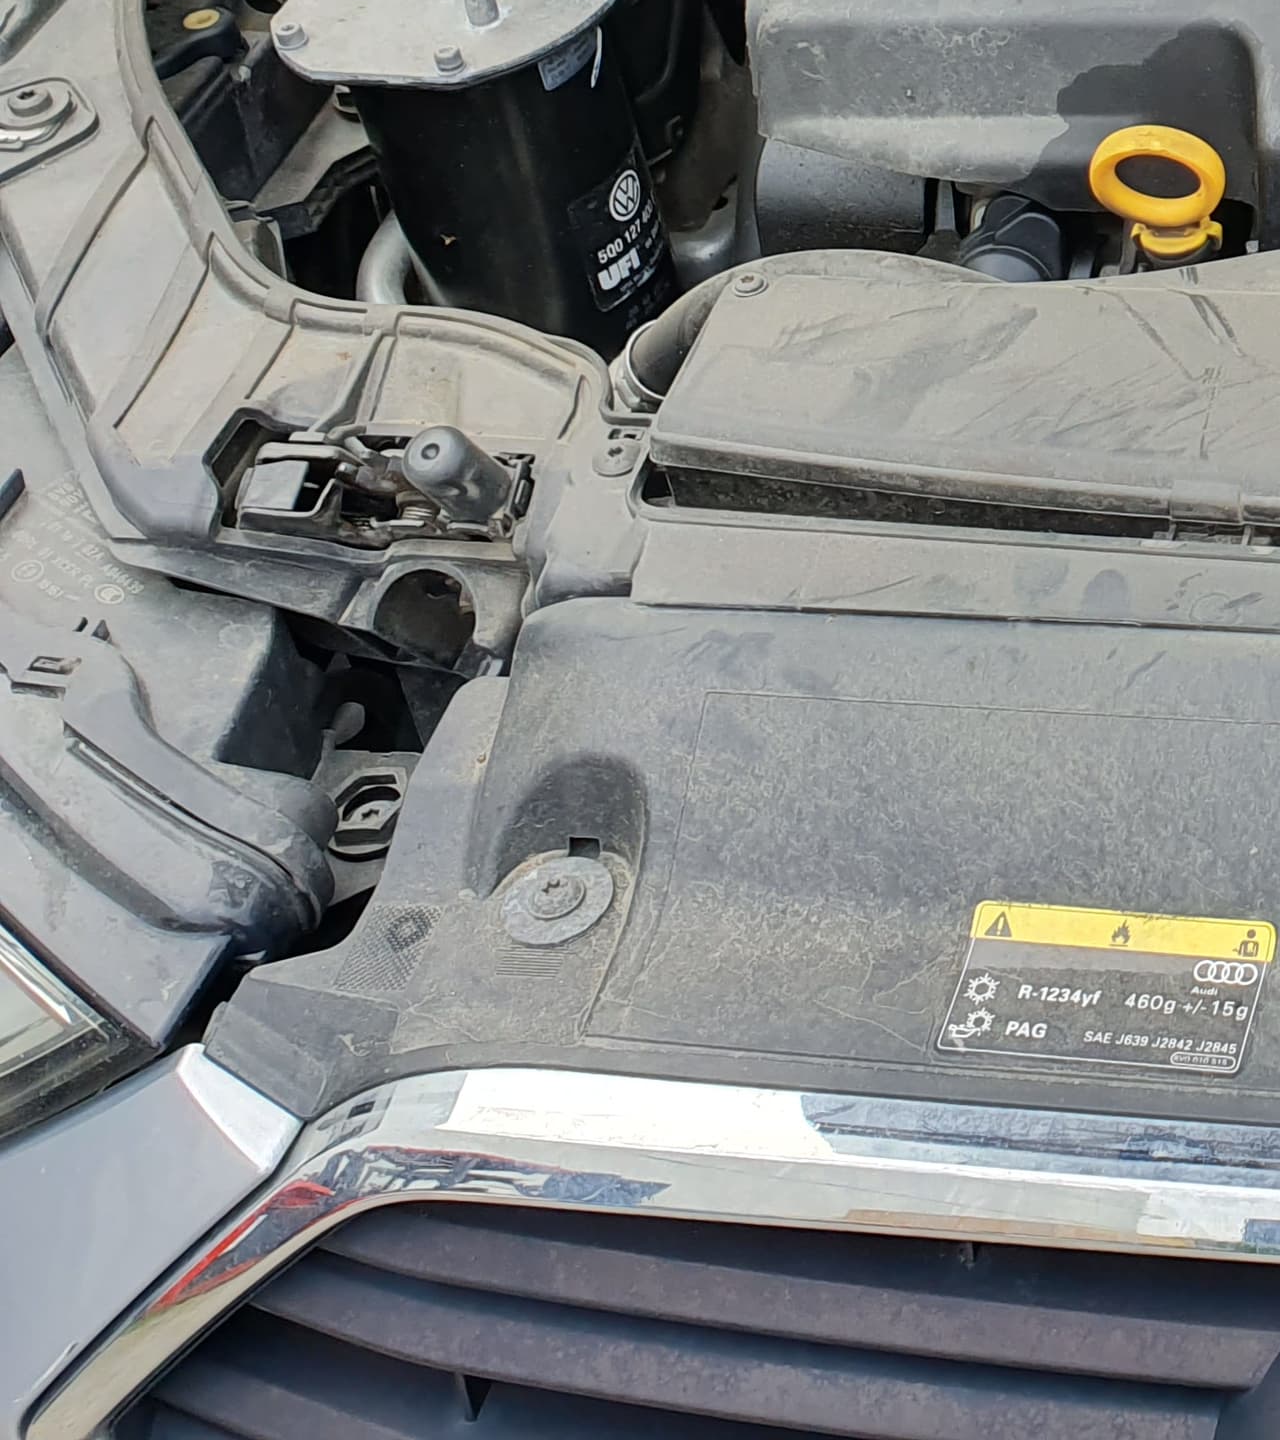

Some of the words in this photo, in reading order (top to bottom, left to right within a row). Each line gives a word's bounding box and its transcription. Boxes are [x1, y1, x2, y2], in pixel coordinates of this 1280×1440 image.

[597, 247, 641, 291] UFI
[1018, 985, 1101, 1006] R-1234yf
[1125, 993, 1177, 1015] 460g
[1190, 986, 1218, 997] Audi
[1005, 1022, 1048, 1039] PAG
[1083, 1030, 1113, 1044] SAE
[1115, 1034, 1149, 1047] J639
[1151, 1037, 1193, 1050] J2842
[1195, 1041, 1237, 1054] J2845
